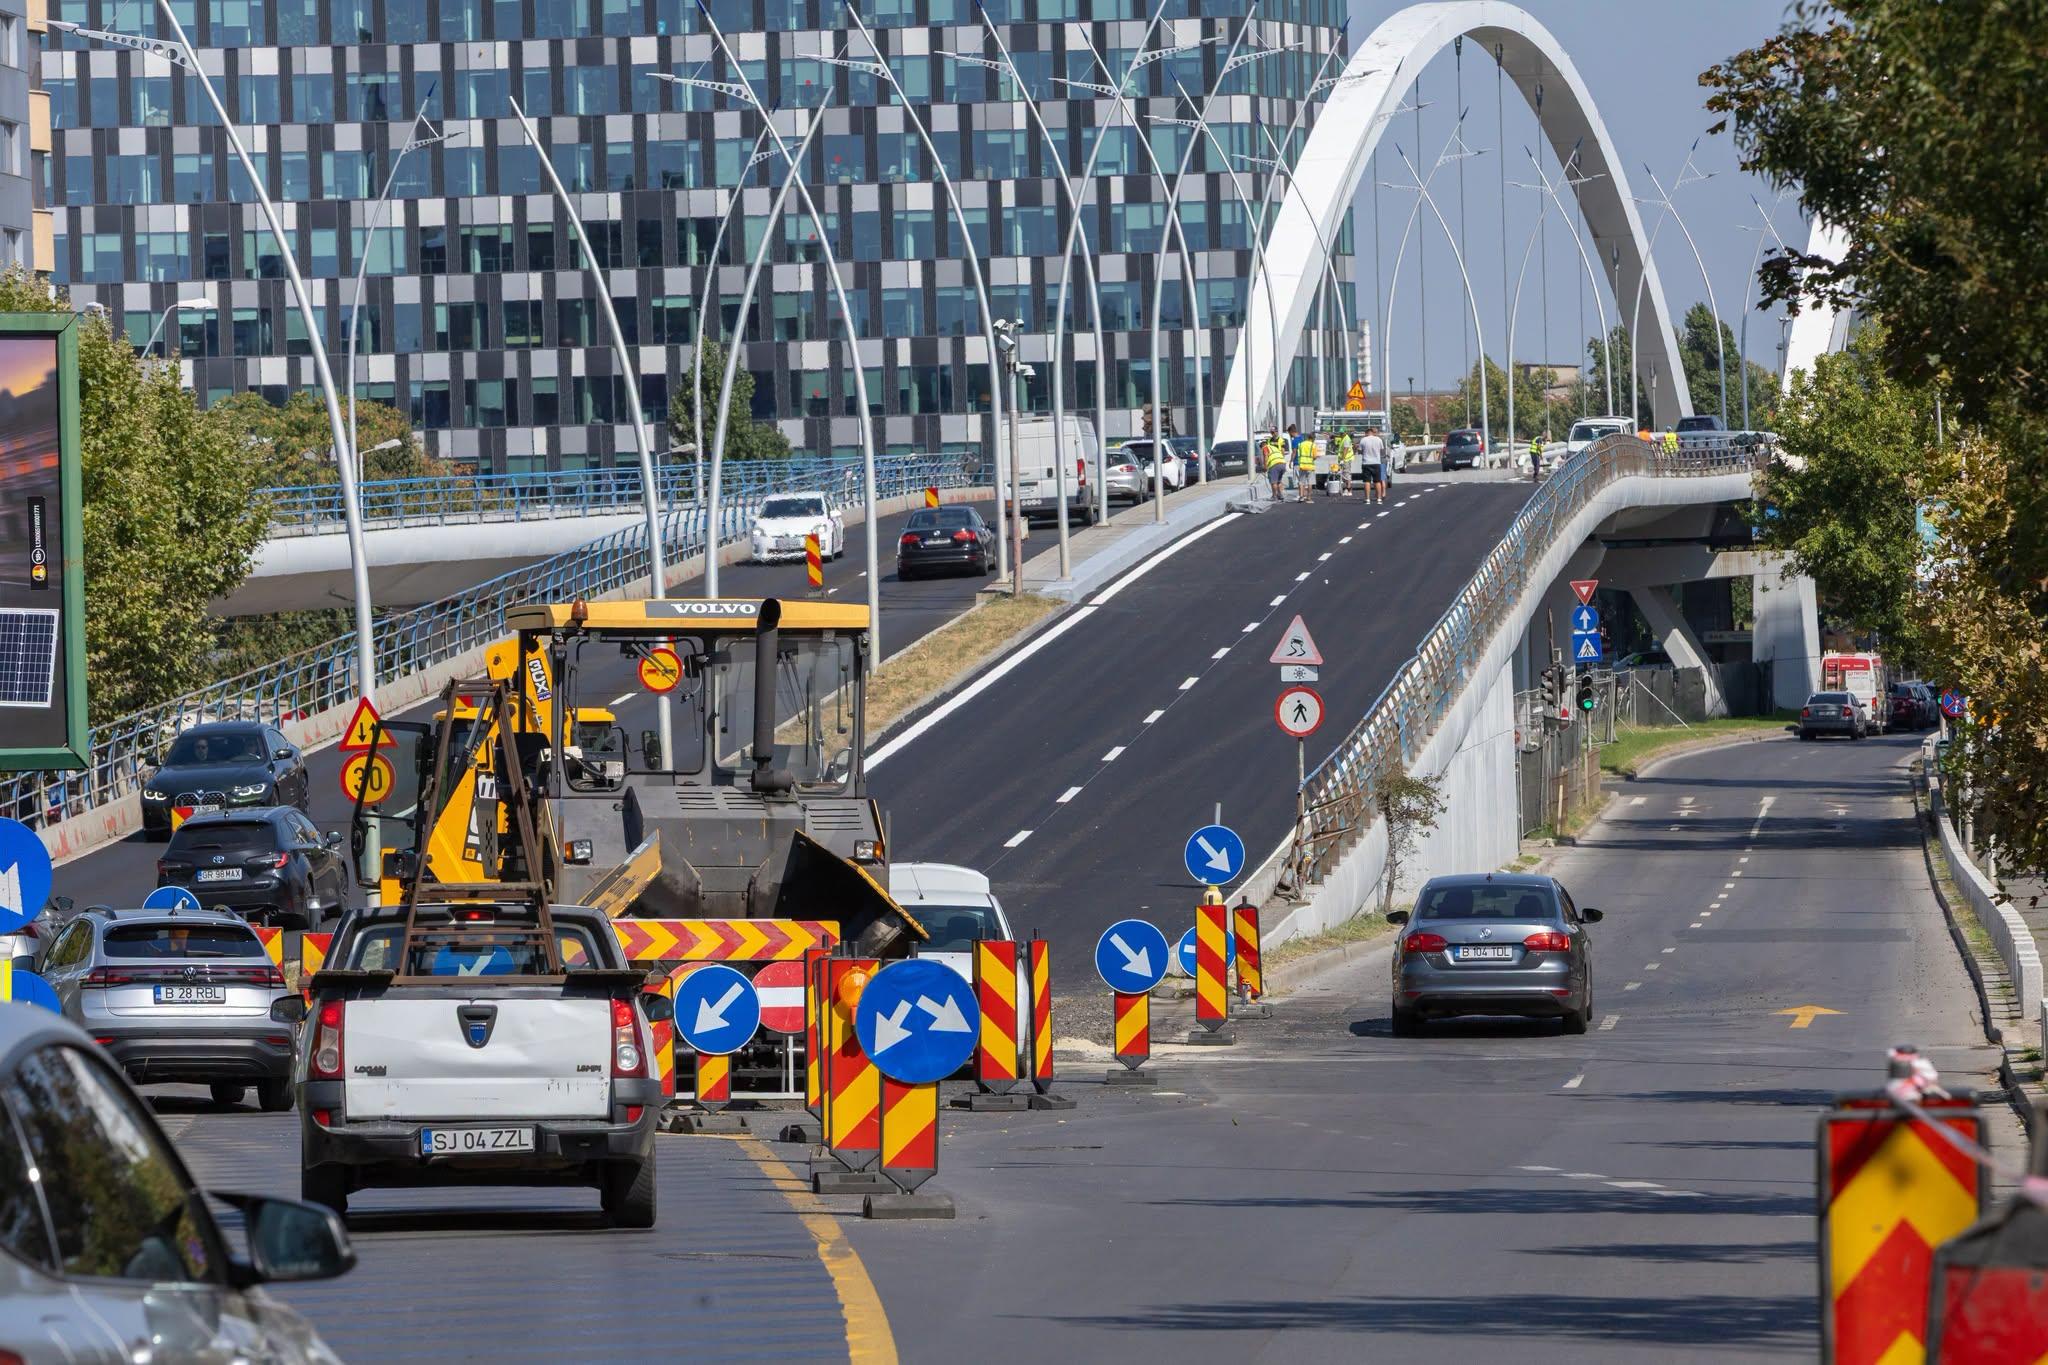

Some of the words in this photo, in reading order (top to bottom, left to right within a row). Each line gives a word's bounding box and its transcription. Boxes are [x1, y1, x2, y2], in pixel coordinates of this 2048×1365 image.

[670, 603, 756, 614] VOLVO
[353, 766, 383, 792] 30
[215, 870, 225, 878] 98
[1462, 947, 1470, 956] B
[1473, 946, 1488, 956] 104
[165, 987, 174, 999] B
[179, 987, 193, 999] 28
[196, 987, 221, 999] RBL
[434, 1132, 457, 1150] SJ
[464, 1131, 486, 1150] 04
[491, 1129, 529, 1148] ZZL
